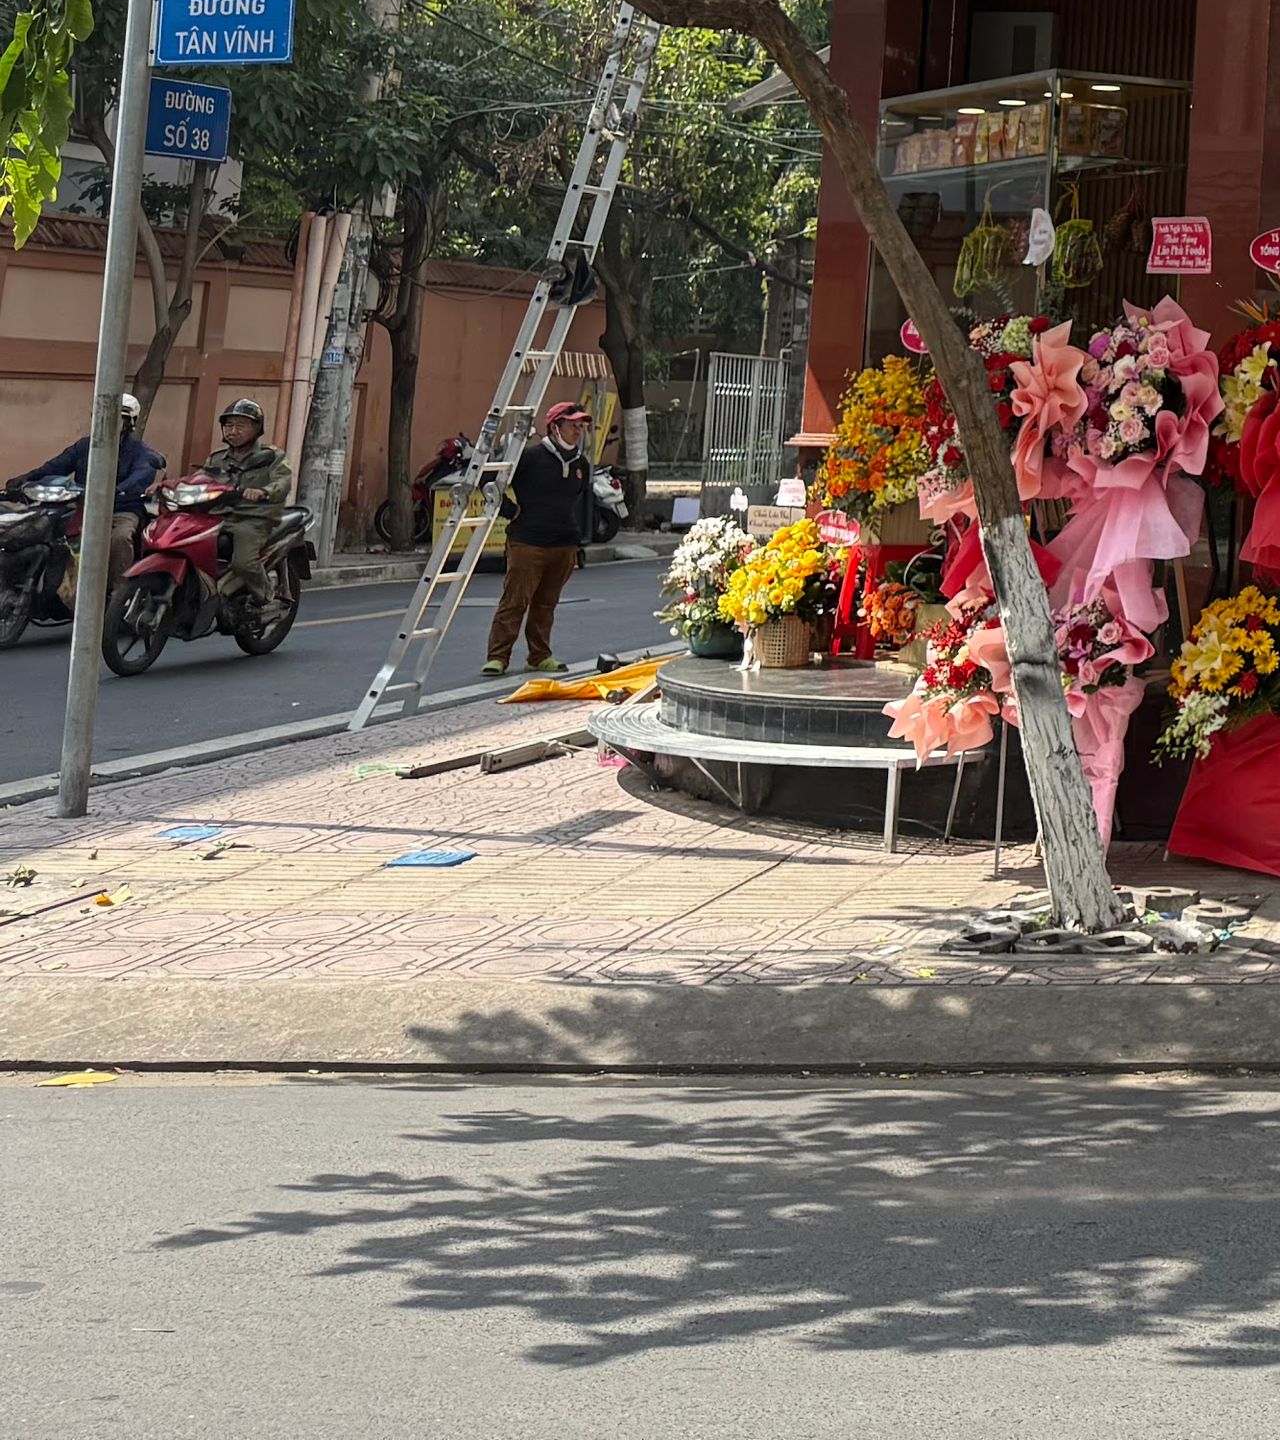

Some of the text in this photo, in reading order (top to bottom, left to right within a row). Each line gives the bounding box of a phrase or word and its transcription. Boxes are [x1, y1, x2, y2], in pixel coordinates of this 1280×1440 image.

[175, 25, 274, 55] TÂN VĨNH
[165, 90, 215, 114] ĐƯỜNG
[163, 117, 210, 150] SỐ 38
